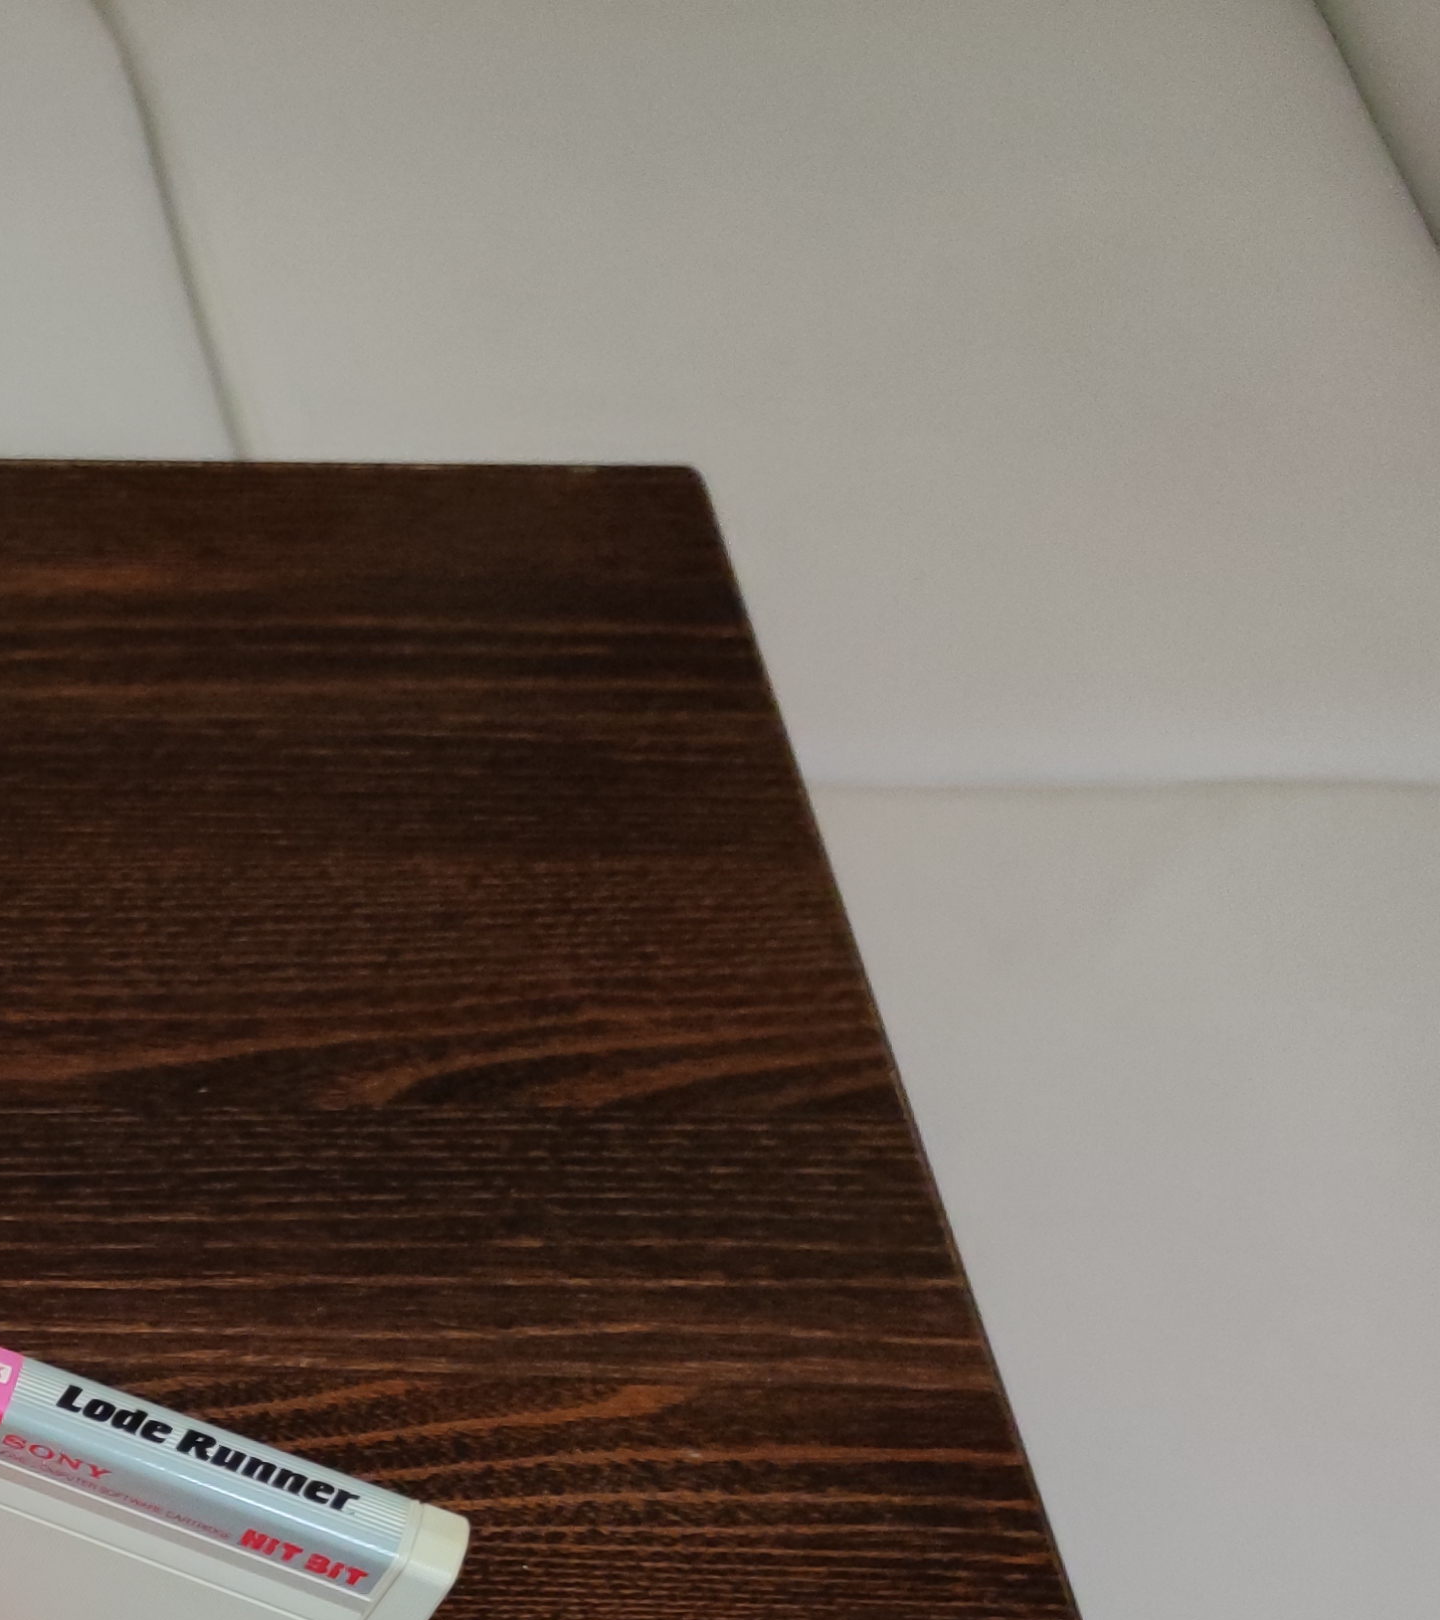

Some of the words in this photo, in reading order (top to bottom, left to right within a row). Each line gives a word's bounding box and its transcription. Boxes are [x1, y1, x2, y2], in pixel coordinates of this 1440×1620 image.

[3, 1434, 113, 1480] SONY
[56, 1384, 174, 1443] Lode
[176, 1428, 361, 1512] Runner
[240, 1528, 303, 1561] HIT
[304, 1553, 369, 1587] BIT
